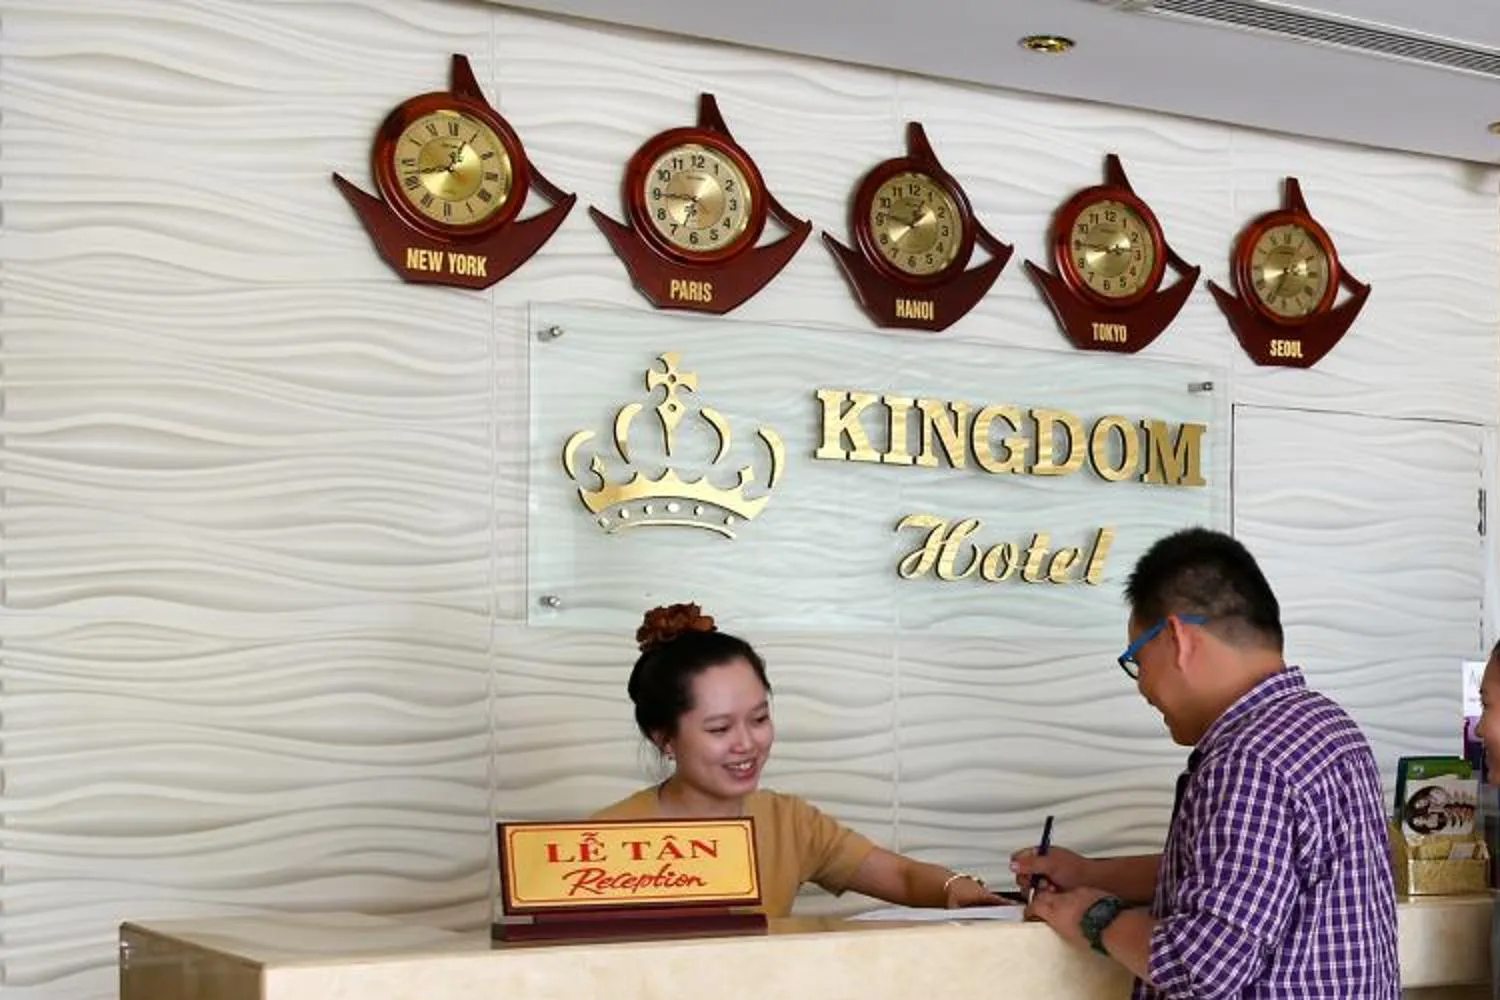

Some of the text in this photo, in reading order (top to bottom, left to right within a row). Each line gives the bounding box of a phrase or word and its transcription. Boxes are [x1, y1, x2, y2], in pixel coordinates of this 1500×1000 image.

[672, 158, 683, 170] 11
[691, 155, 704, 168] 12
[658, 169, 671, 182] 10
[725, 180, 734, 191] 2
[909, 184, 920, 196] 12
[653, 188, 661, 200] 9
[892, 187, 902, 197] 11
[729, 200, 737, 211] 3
[880, 197, 891, 208] 10
[657, 208, 666, 220] 8
[937, 207, 945, 217] 2
[1104, 211, 1116, 222] 12
[723, 218, 730, 228] 4
[876, 213, 884, 225] 9
[1089, 213, 1099, 224] 11
[670, 224, 678, 234] 7
[710, 229, 718, 240] 5
[941, 225, 948, 236] 3
[1079, 224, 1088, 235] 10
[689, 232, 698, 244] 6
[880, 234, 888, 244] 8
[1131, 232, 1139, 243] 2
[936, 242, 944, 252] 4
[891, 248, 899, 258] 7
[1135, 250, 1141, 261] 3
[407, 248, 487, 277] NEW YORK
[908, 256, 916, 267] 6
[926, 254, 933, 264] 5
[1078, 258, 1084, 269] 8
[1129, 266, 1136, 276] 4
[1088, 272, 1095, 282] 7
[1120, 276, 1126, 287] 5
[1104, 280, 1110, 290] 6
[670, 279, 712, 303] PARIS
[896, 299, 934, 320] HANOI
[1092, 323, 1127, 342] TOKYO
[1270, 339, 1303, 358] SEOUL
[813, 388, 1208, 487] KINGDOM
[895, 513, 1118, 586] Hotel
[544, 832, 718, 863] LỄ TÂN
[562, 863, 708, 896] Reception
